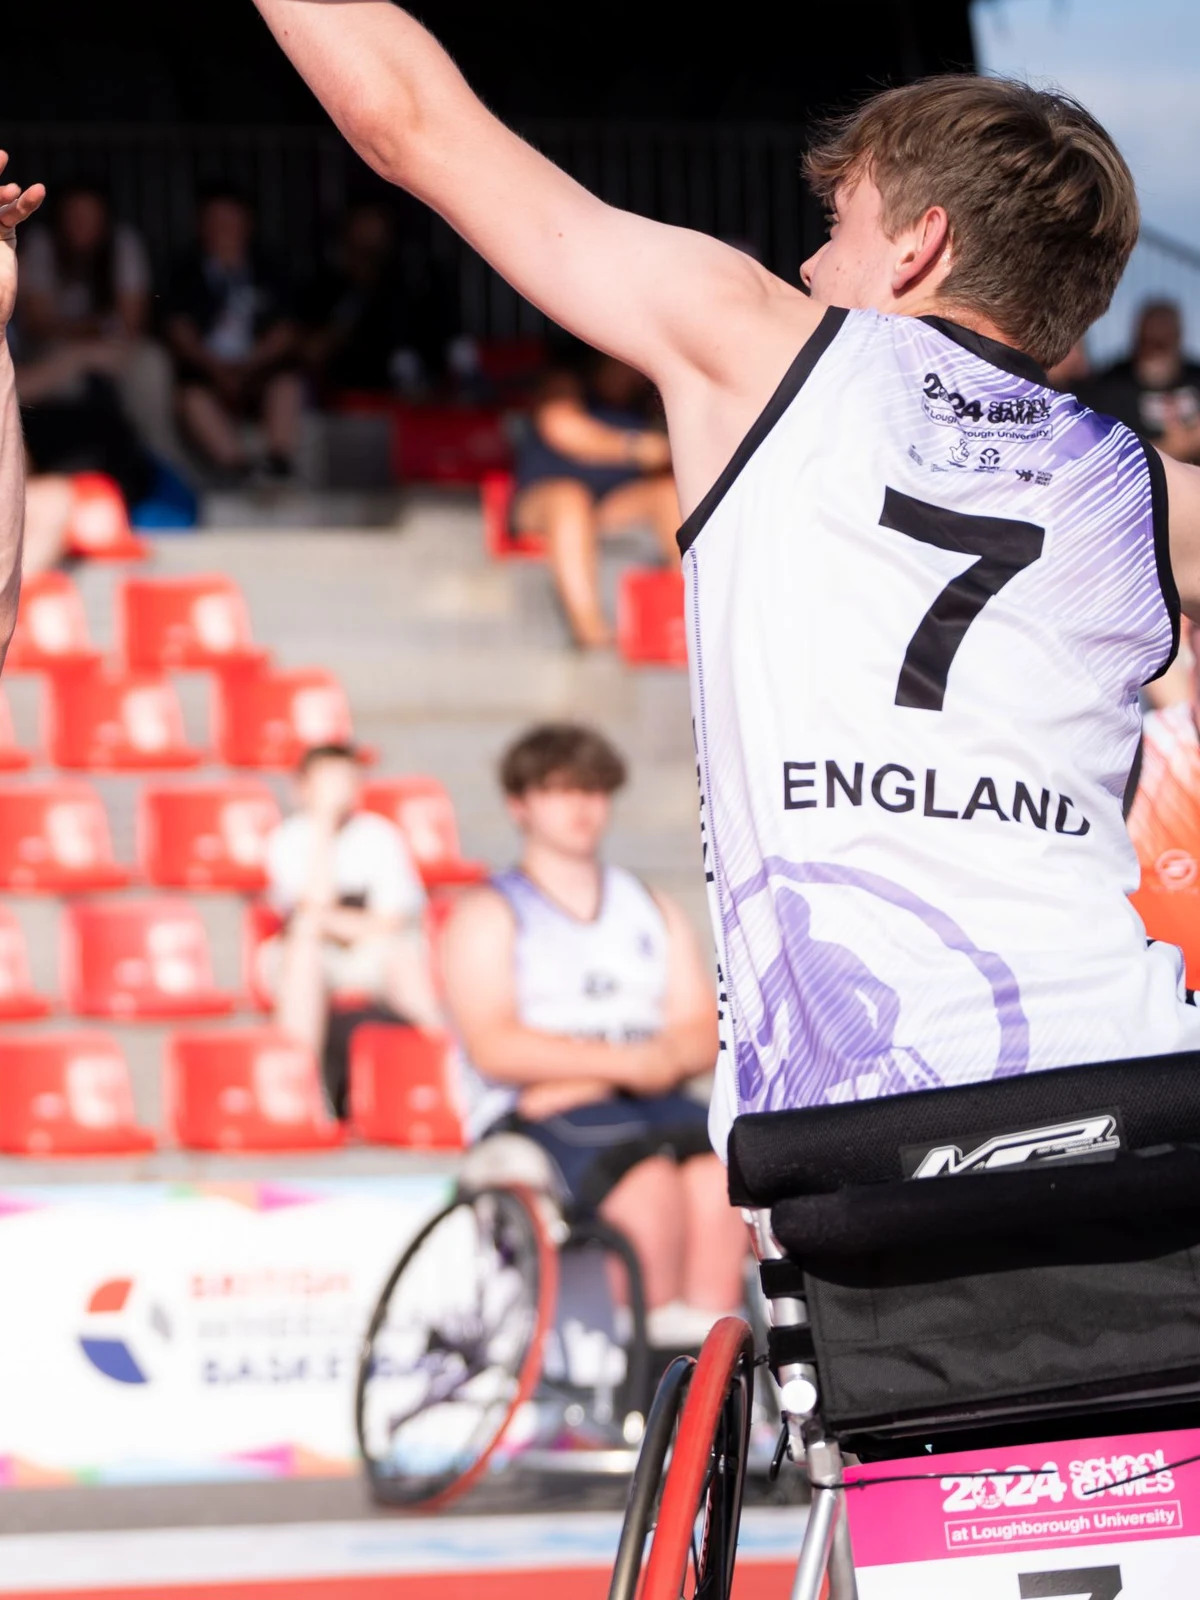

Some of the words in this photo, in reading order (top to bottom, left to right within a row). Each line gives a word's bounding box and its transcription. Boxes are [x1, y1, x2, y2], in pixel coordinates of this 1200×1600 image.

[987, 410, 1050, 424] GAMES
[989, 397, 1051, 413] SCHOOL
[997, 429, 1049, 440] University
[878, 485, 1045, 712] 7
[783, 760, 1090, 836] ENGLAND
[1068, 1449, 1170, 1481] SCHOOL
[941, 1461, 1067, 1513] 2024
[1072, 1470, 1175, 1500] GAMES
[952, 1527, 969, 1542] at
[972, 1516, 1090, 1540] Loughborough
[1094, 1509, 1175, 1529] University
